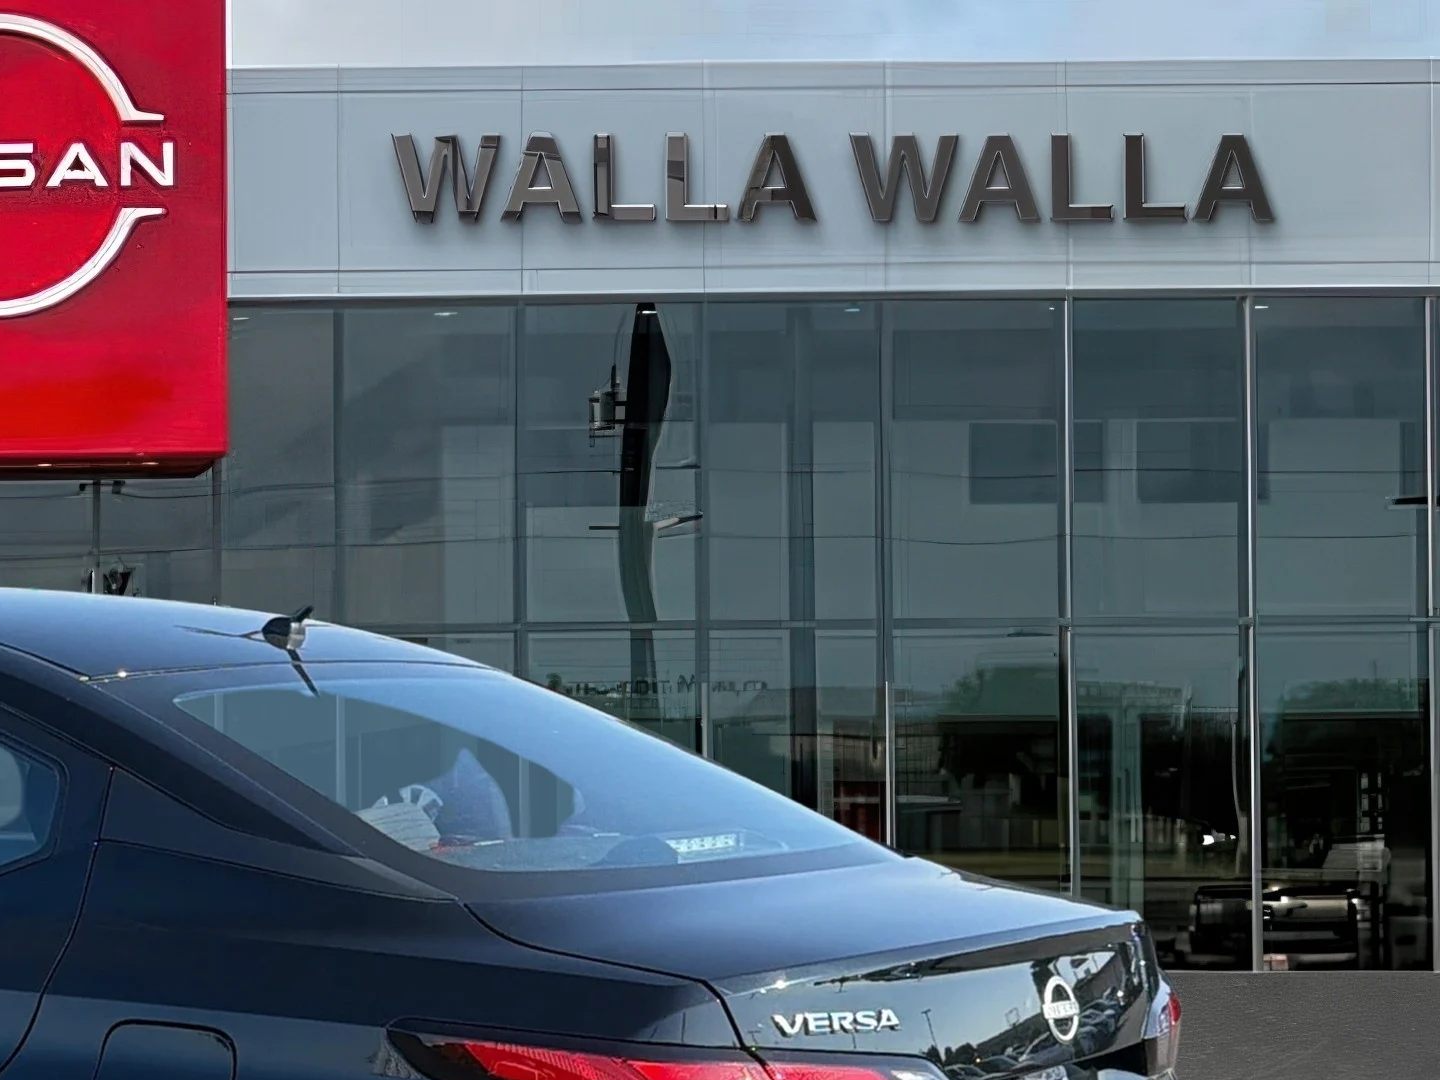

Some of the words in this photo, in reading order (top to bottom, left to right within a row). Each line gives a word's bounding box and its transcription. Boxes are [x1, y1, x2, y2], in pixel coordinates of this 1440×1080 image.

[391, 131, 817, 225] WALLA
[849, 131, 1275, 224] WALLA
[771, 1008, 901, 1037] VERSA
